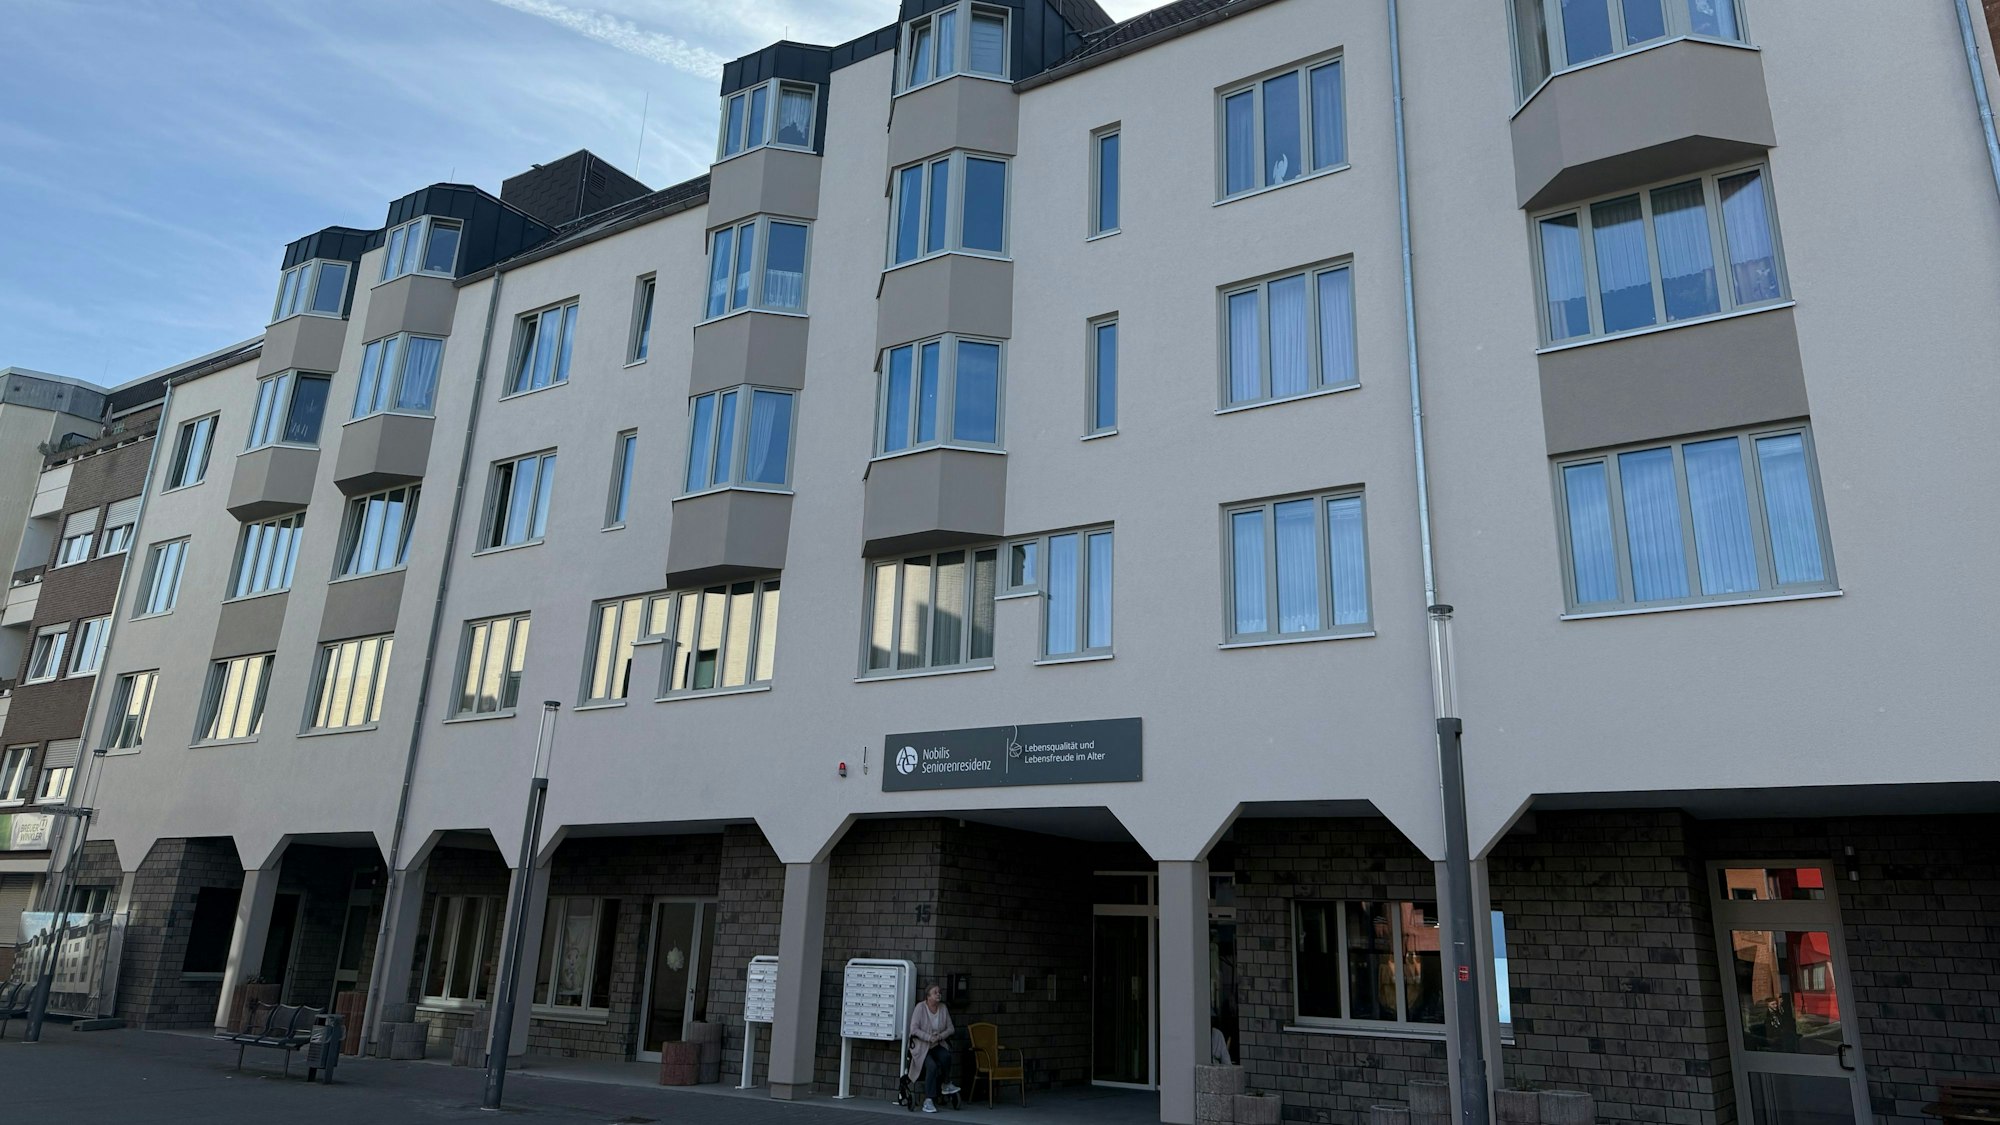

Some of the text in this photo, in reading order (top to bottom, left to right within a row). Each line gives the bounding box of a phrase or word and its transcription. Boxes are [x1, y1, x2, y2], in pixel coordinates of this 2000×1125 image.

[922, 746, 950, 760] Nobilis
[1024, 739, 1095, 753] Lebensqualität und
[1024, 751, 1106, 764] Lebensfreude im Alter
[921, 757, 992, 774] Seniorenresidenz
[915, 904, 931, 923] 15
